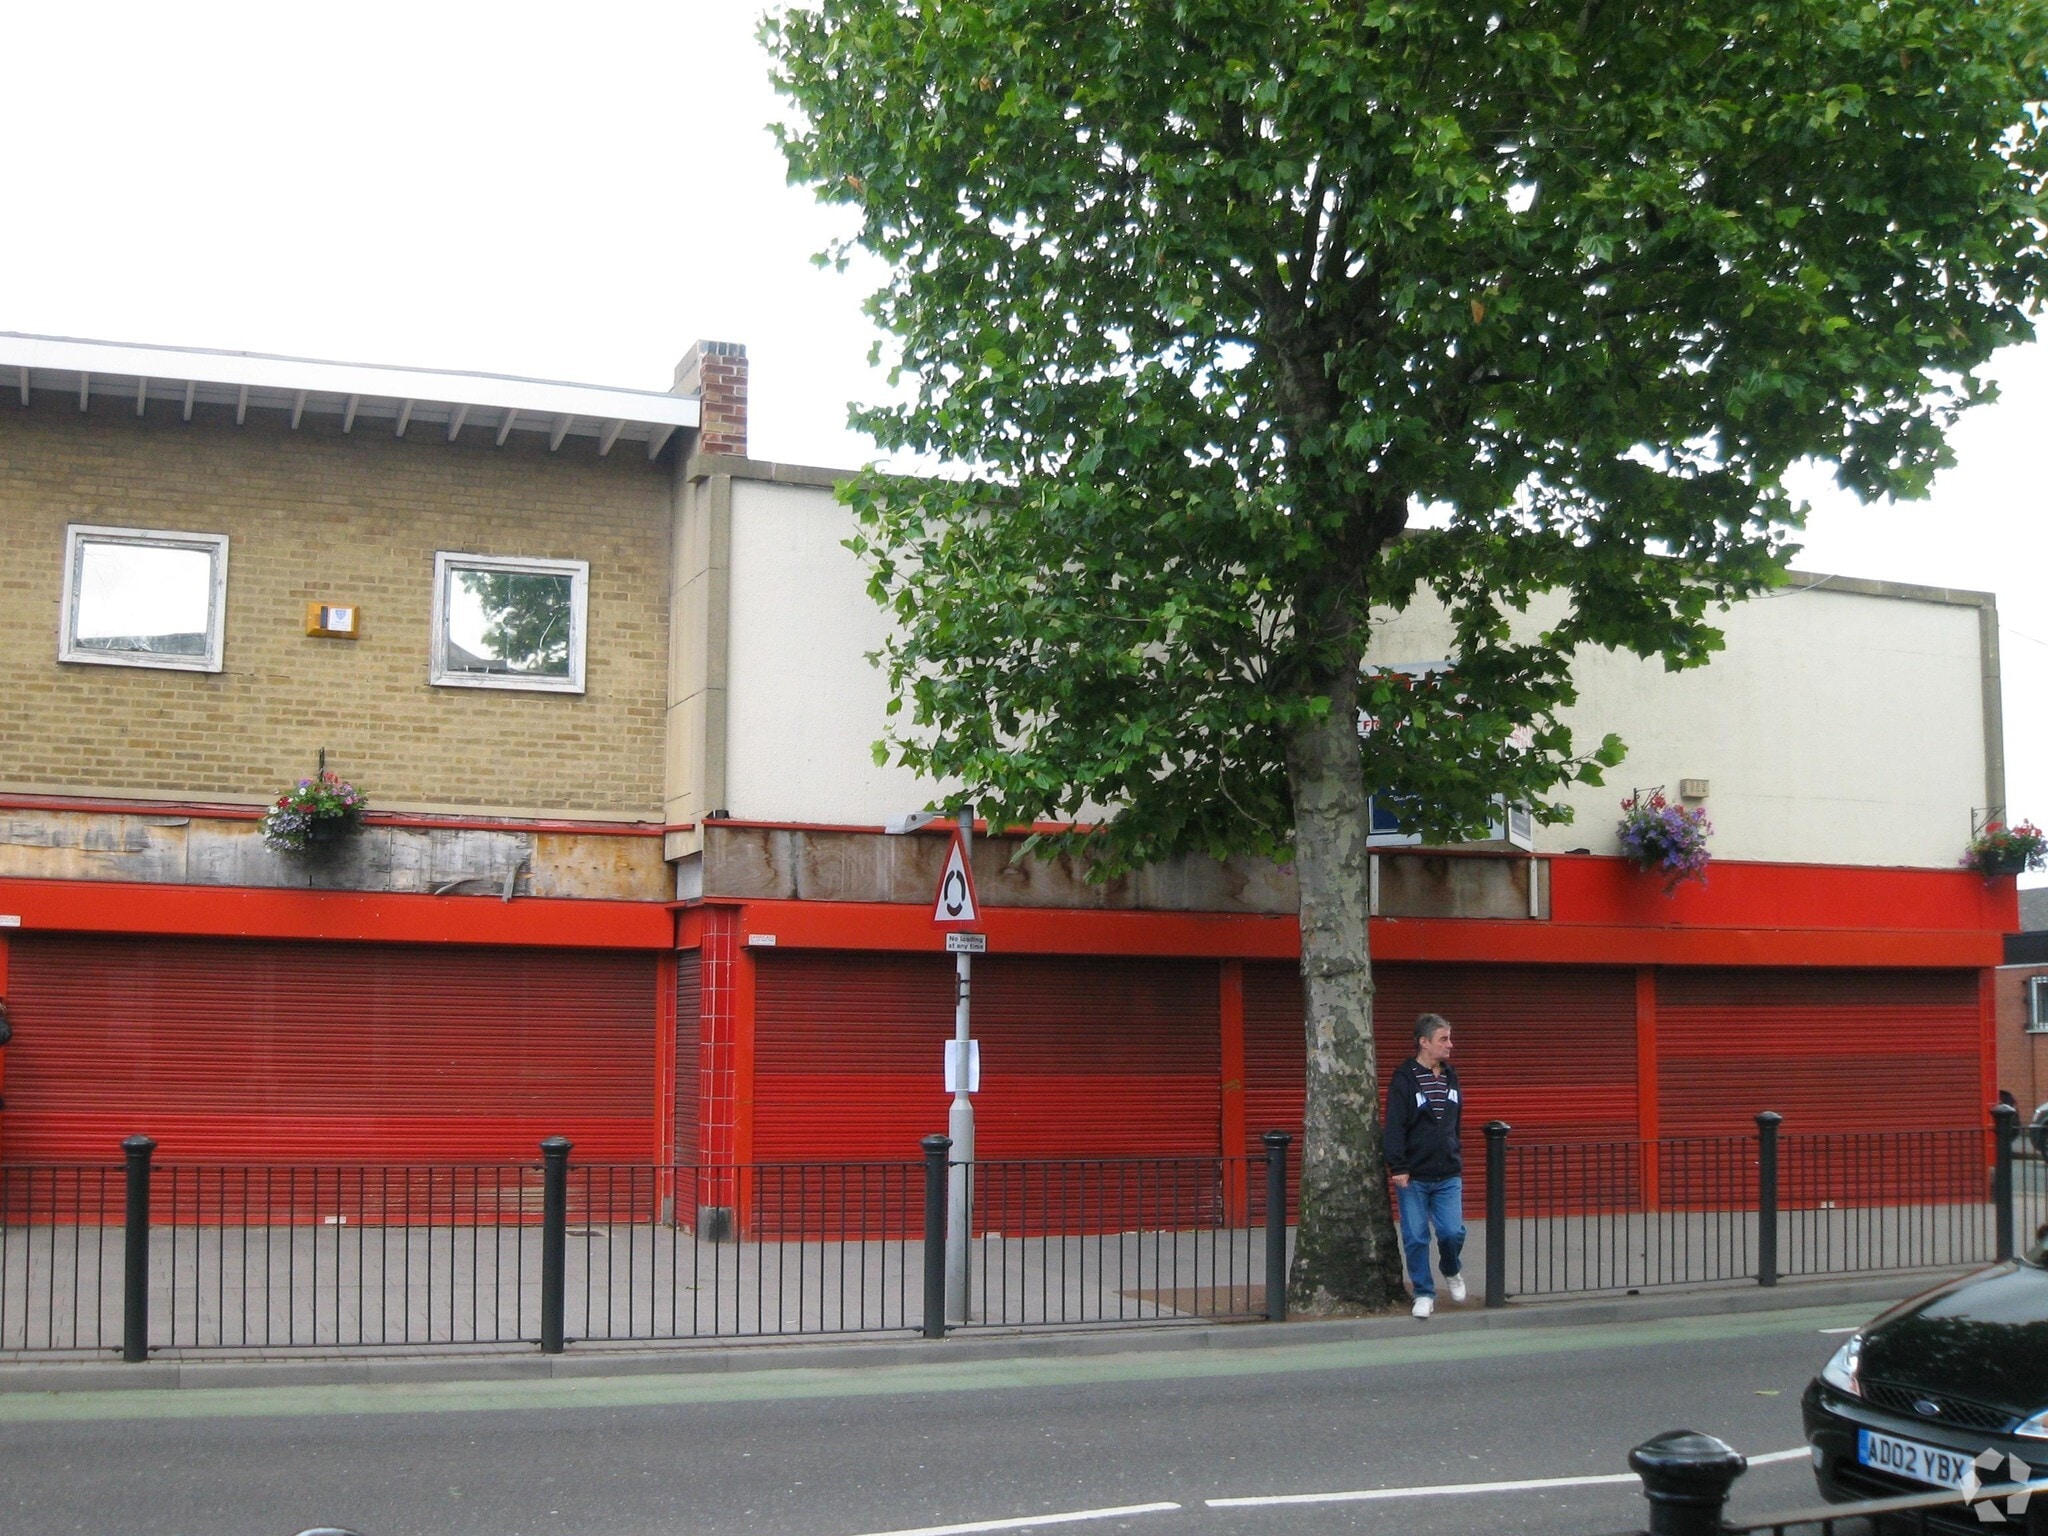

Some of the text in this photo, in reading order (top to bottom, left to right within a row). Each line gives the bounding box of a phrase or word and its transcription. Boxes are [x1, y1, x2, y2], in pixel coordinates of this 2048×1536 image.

[960, 935, 984, 944] loading
[1869, 1436, 1965, 1485] AD02 YBX
